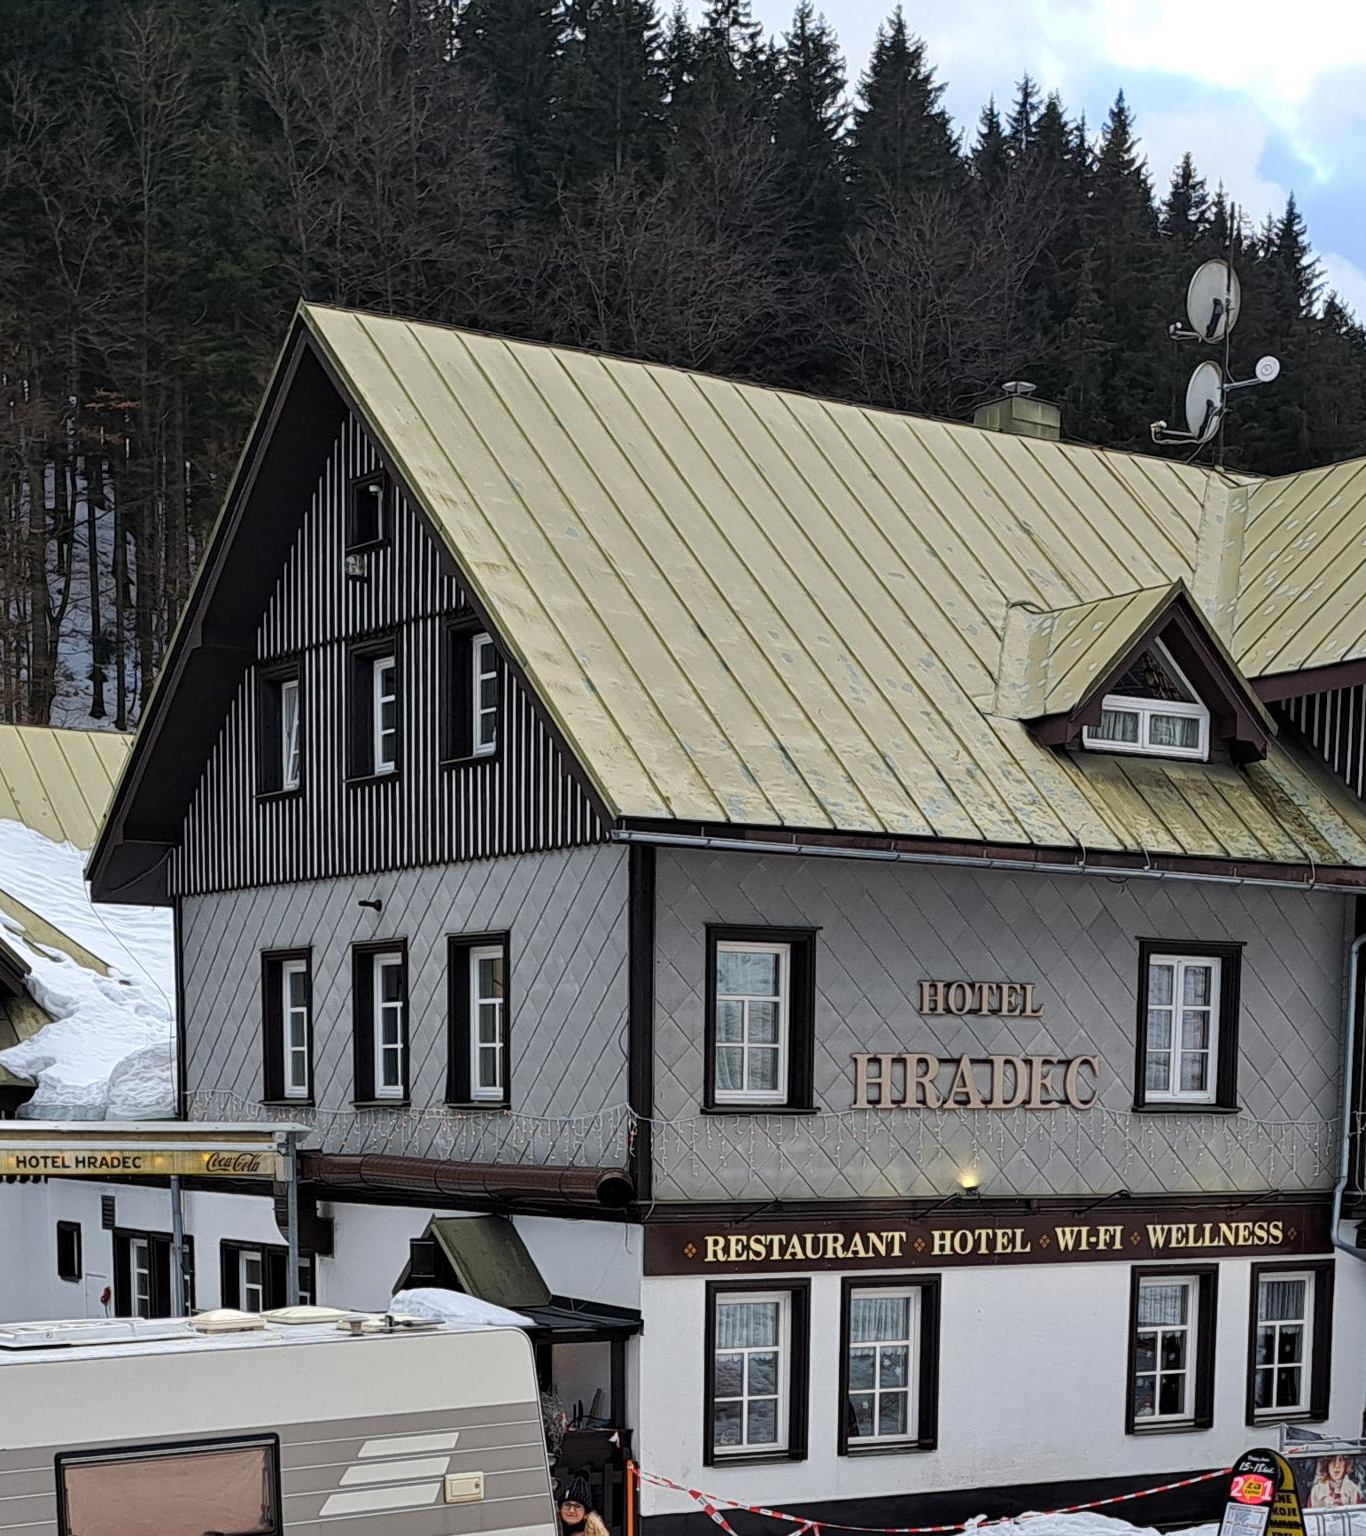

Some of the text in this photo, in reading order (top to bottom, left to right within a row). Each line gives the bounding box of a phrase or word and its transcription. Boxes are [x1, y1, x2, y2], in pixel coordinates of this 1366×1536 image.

[919, 980, 1043, 1017] HOTEL
[851, 1053, 1100, 1109] HRADEC
[16, 1155, 141, 1169] HOTEL HRADEC
[205, 1152, 261, 1173] Coca-Cola
[704, 1221, 1284, 1262] RESTAURANT HOTEL WI-FI WELLNESS
